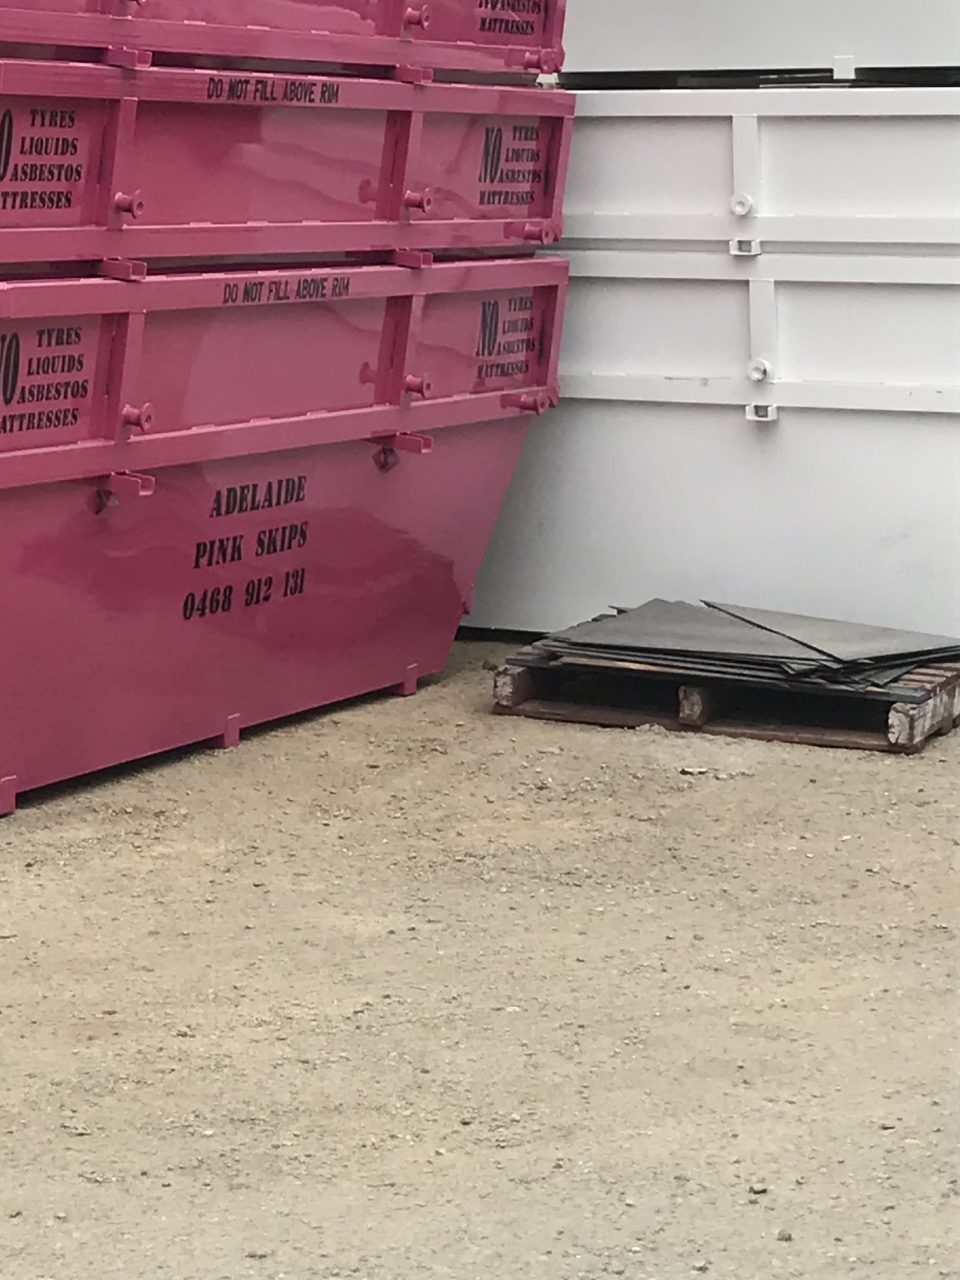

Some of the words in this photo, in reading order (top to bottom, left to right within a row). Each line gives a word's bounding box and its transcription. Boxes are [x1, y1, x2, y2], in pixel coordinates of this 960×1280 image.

[207, 77, 223, 99] DO
[227, 79, 250, 101] NOT
[253, 80, 277, 101] FILL
[282, 81, 317, 103] ABOVE
[320, 83, 339, 103] RIM
[30, 109, 75, 128] TYRES
[20, 137, 78, 155] LIQUIDS
[478, 127, 502, 183] NO
[10, 164, 82, 182] ASBESTOS
[223, 283, 238, 304] DO
[243, 282, 264, 302] NOT
[267, 281, 290, 301] FILL
[295, 278, 328, 299] ABOVE
[331, 277, 350, 297] RIM
[37, 326, 81, 347] TYRES
[476, 300, 499, 357] NO
[27, 354, 83, 376] LIQUIDS
[17, 379, 88, 404] ASBESTOS
[210, 476, 306, 517] ADELAIDE
[193, 535, 243, 569] PINK
[256, 521, 308, 556] SKIPS
[183, 585, 233, 620] 0468
[245, 577, 272, 607] 912
[283, 568, 305, 597] 131
